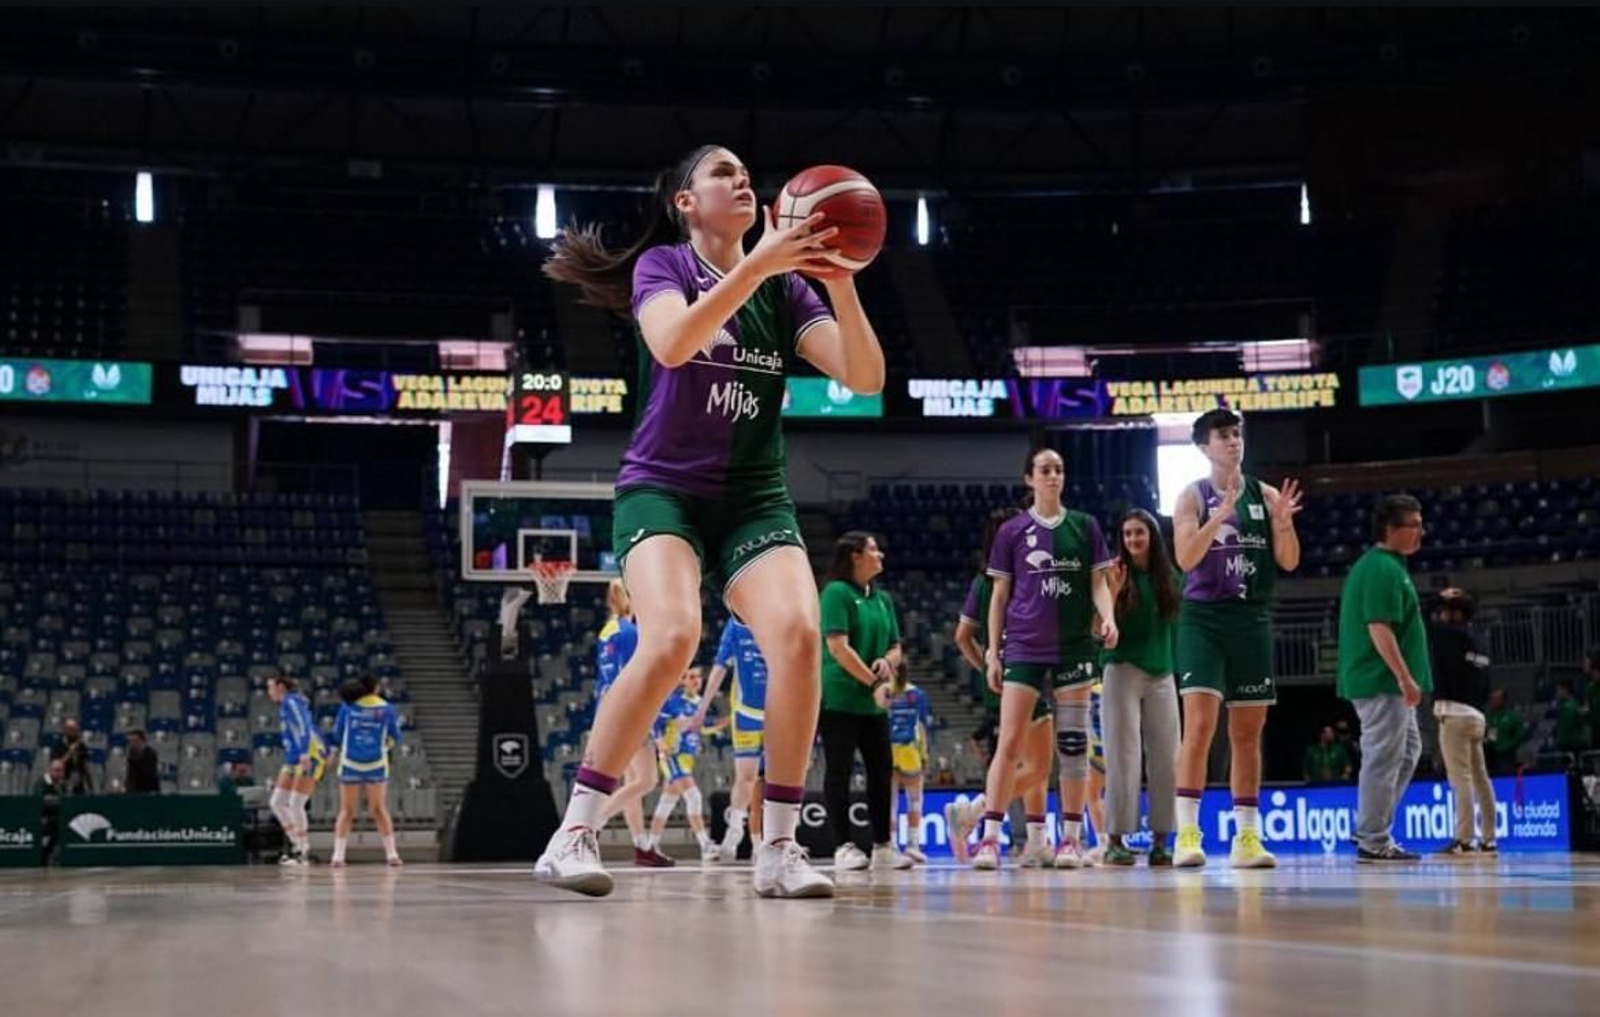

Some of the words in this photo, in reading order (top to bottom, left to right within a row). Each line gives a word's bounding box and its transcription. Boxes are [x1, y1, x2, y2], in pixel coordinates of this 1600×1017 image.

[732, 347, 783, 371] Unicaja
[180, 365, 288, 388] UNICAJA
[522, 373, 562, 390] 20:0
[1106, 381, 1156, 397] VEGA
[1264, 373, 1340, 391] TOYOTA
[1430, 365, 1475, 395] J20
[196, 387, 273, 406] MIJAS
[908, 379, 1007, 399] UNICAJA
[522, 396, 564, 424] 24
[706, 380, 760, 422] Mijas
[923, 397, 994, 417] MIJAS
[1225, 554, 1257, 577] Mijas
[1041, 577, 1072, 598] Mijas
